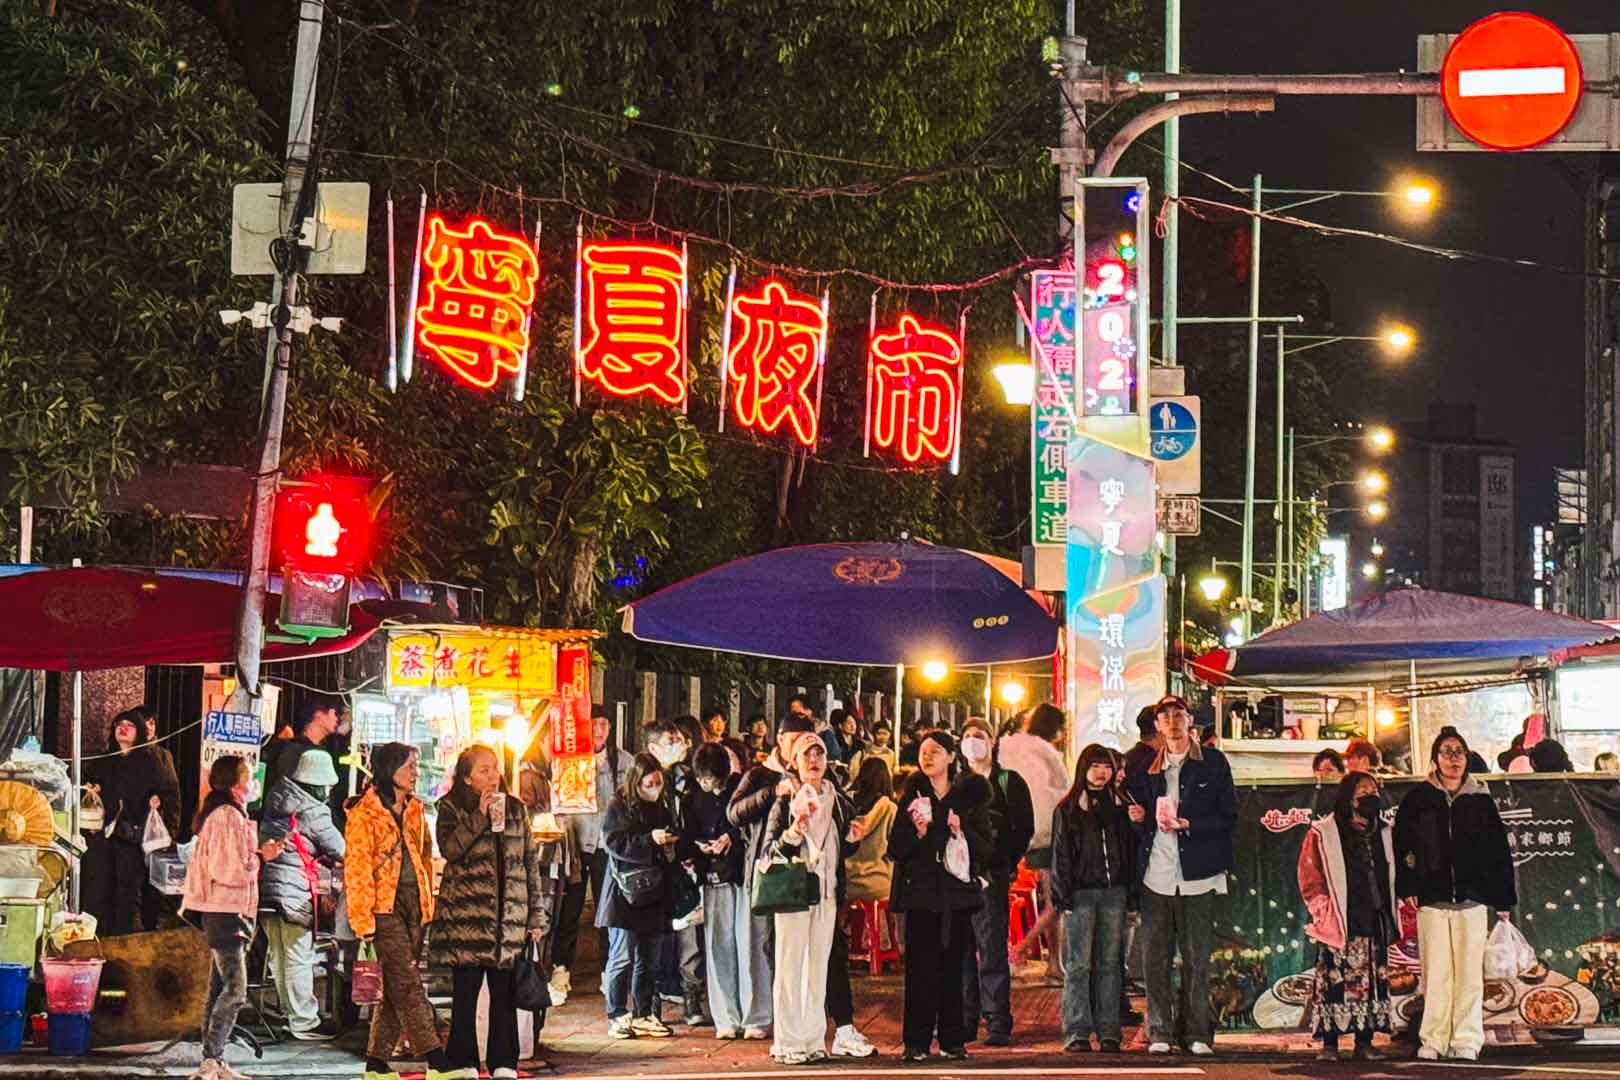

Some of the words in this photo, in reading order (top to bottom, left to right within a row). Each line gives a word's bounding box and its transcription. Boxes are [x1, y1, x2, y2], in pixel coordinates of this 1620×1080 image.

[416, 215, 961, 463] 寧夏夜市
[400, 643, 522, 679] 蒸煮花生
